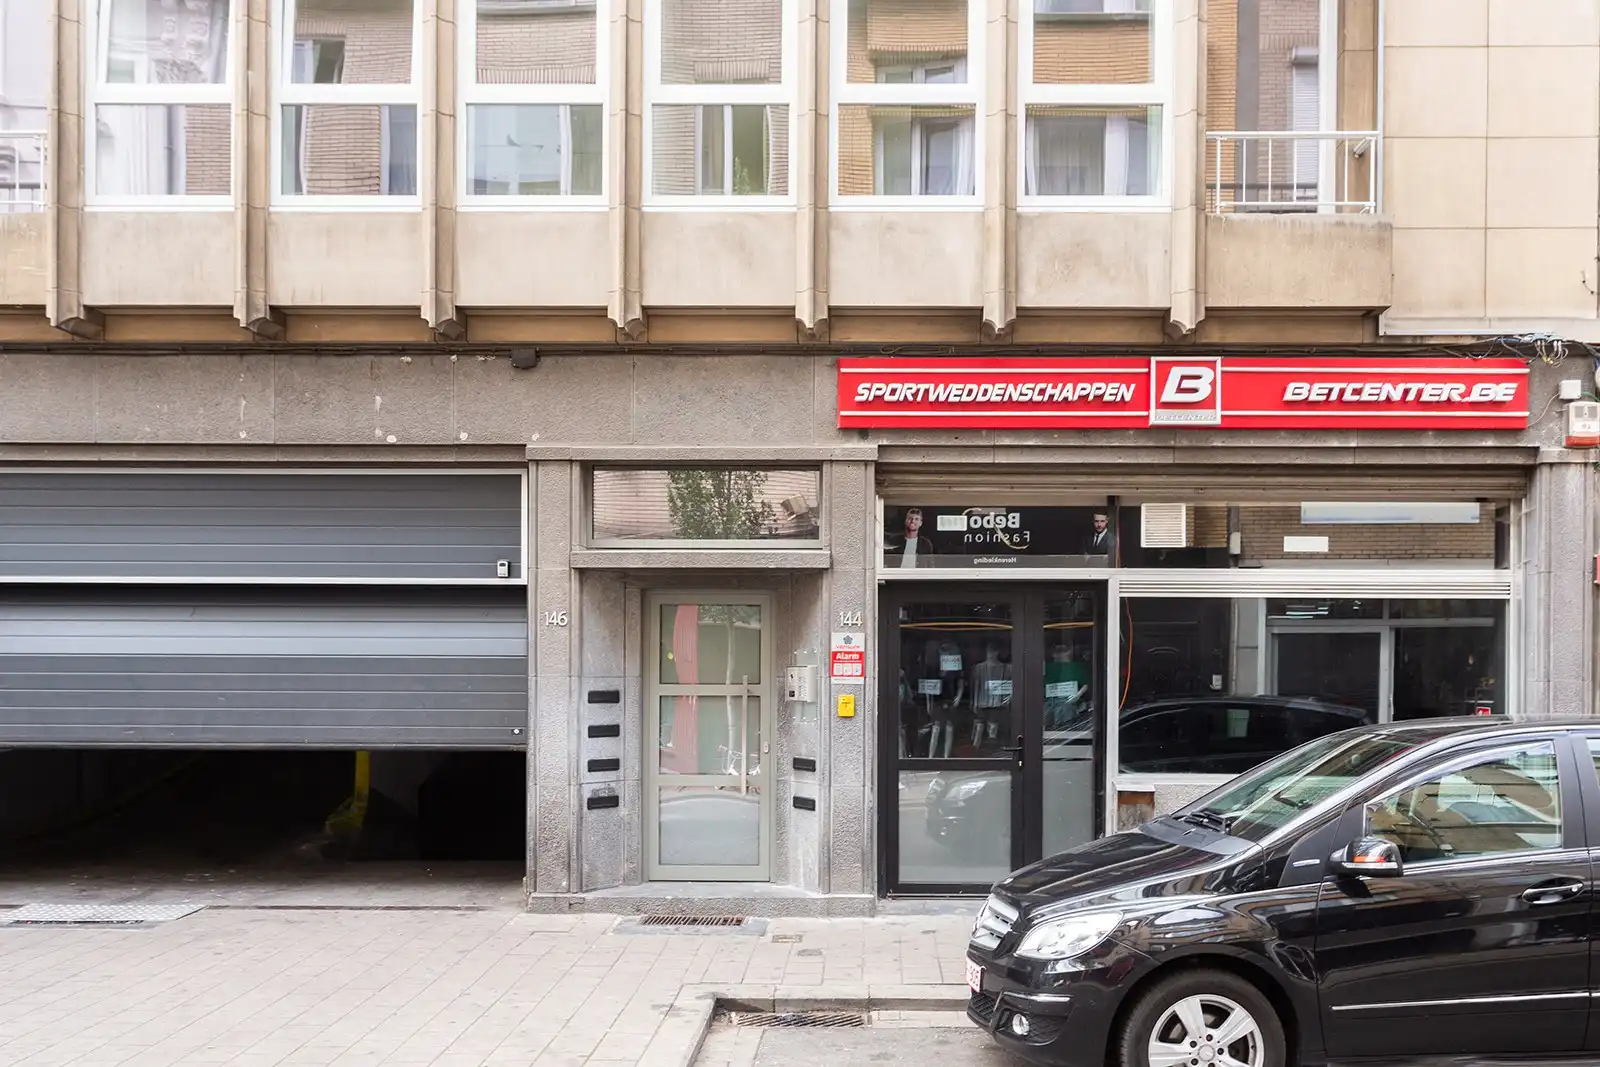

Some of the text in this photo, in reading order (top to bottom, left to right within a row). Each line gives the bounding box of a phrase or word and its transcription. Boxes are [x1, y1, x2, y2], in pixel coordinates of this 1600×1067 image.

[854, 382, 1136, 403] SPORTWEDDENSCHAPPEN
[1160, 366, 1215, 403] B
[1282, 382, 1519, 403] BETCENTER.BE
[544, 611, 568, 626] 146
[839, 611, 863, 627] 144
[836, 652, 859, 660] Alarm
